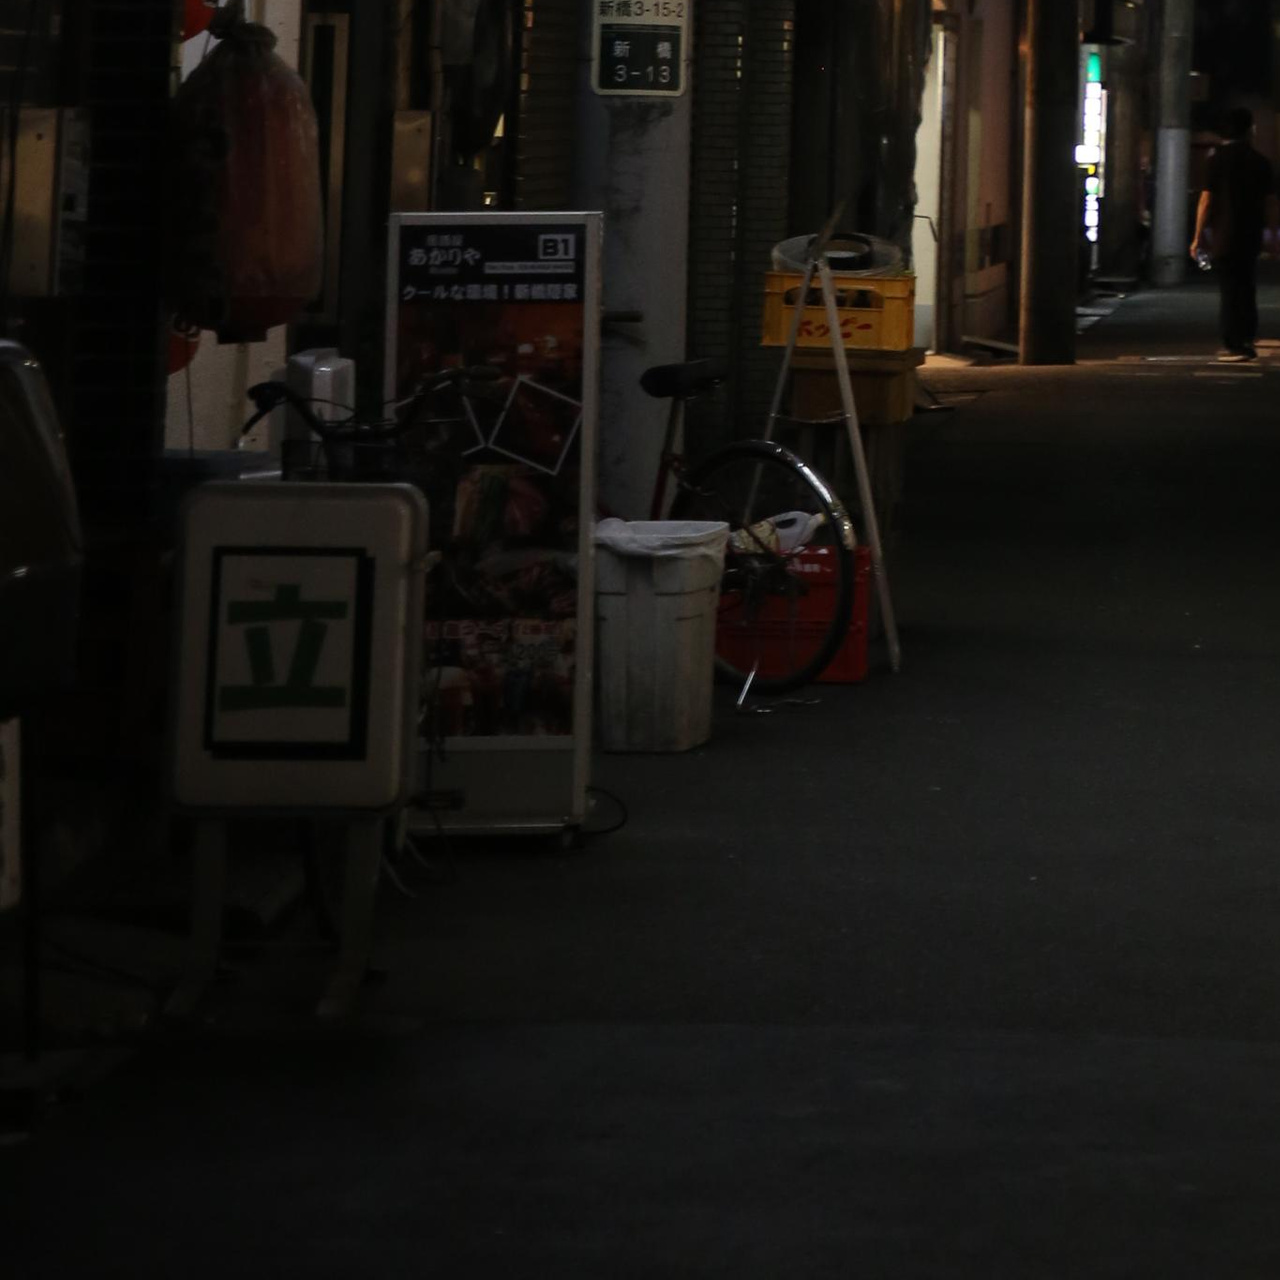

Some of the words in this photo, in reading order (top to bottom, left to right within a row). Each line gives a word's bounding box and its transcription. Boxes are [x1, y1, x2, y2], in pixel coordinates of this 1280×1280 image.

[600, 0, 685, 18] 新橋3-15-2
[614, 64, 672, 84] 3-13
[542, 238, 570, 257] B1
[219, 583, 348, 712] 立
